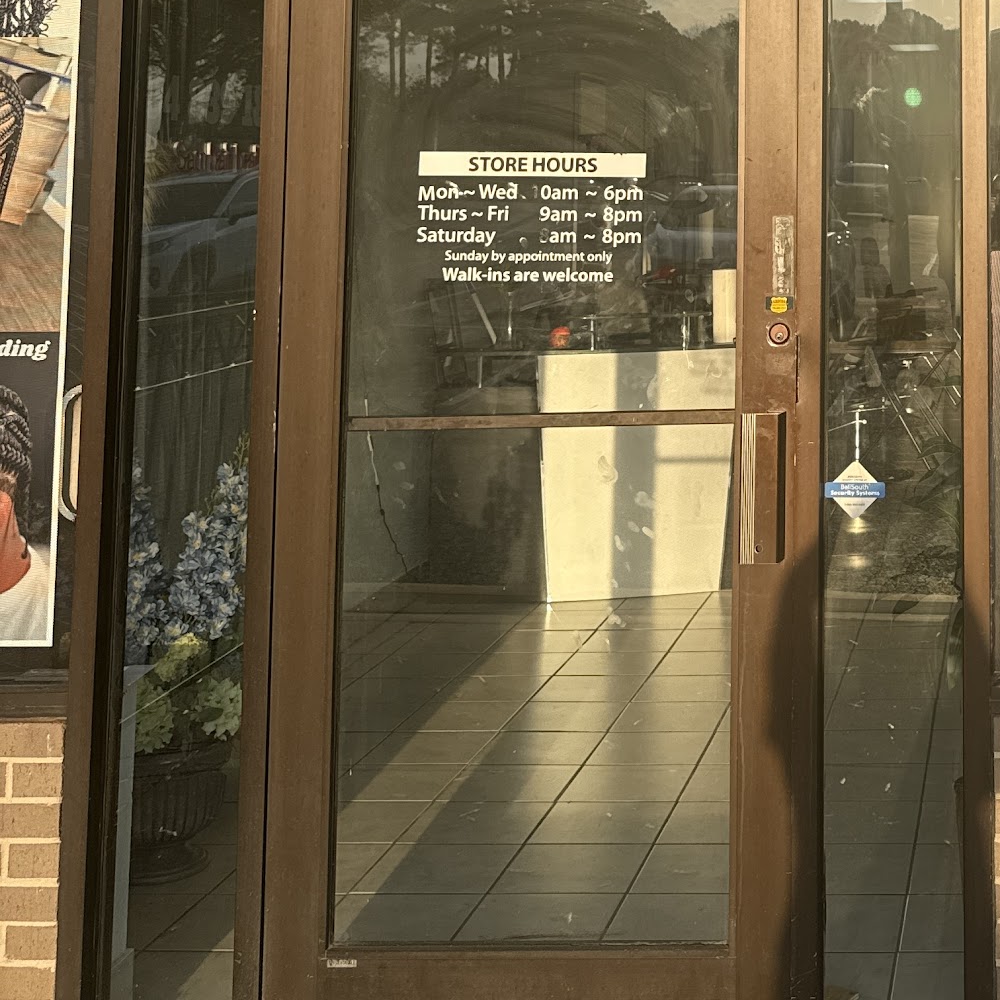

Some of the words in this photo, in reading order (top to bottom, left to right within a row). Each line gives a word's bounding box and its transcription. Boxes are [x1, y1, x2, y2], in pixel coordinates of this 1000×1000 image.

[468, 157, 528, 172] STORE
[532, 157, 598, 173] HOURS
[418, 185, 459, 201] Mon
[478, 183, 519, 200] Wed
[603, 185, 643, 204] 6pm
[417, 204, 467, 221] Thurs
[487, 205, 510, 221] Fri
[539, 206, 578, 222] 9am
[602, 207, 642, 226] 8pm
[416, 227, 496, 247] Saturday
[601, 229, 642, 248] 8pm
[444, 250, 488, 264] Sunday
[491, 250, 506, 264] by
[508, 251, 585, 264] appointment
[587, 250, 613, 265] only
[442, 267, 511, 282] Walk-ins
[513, 270, 540, 282] are
[543, 268, 614, 283] welcome
[0, 339, 51, 361] ding
